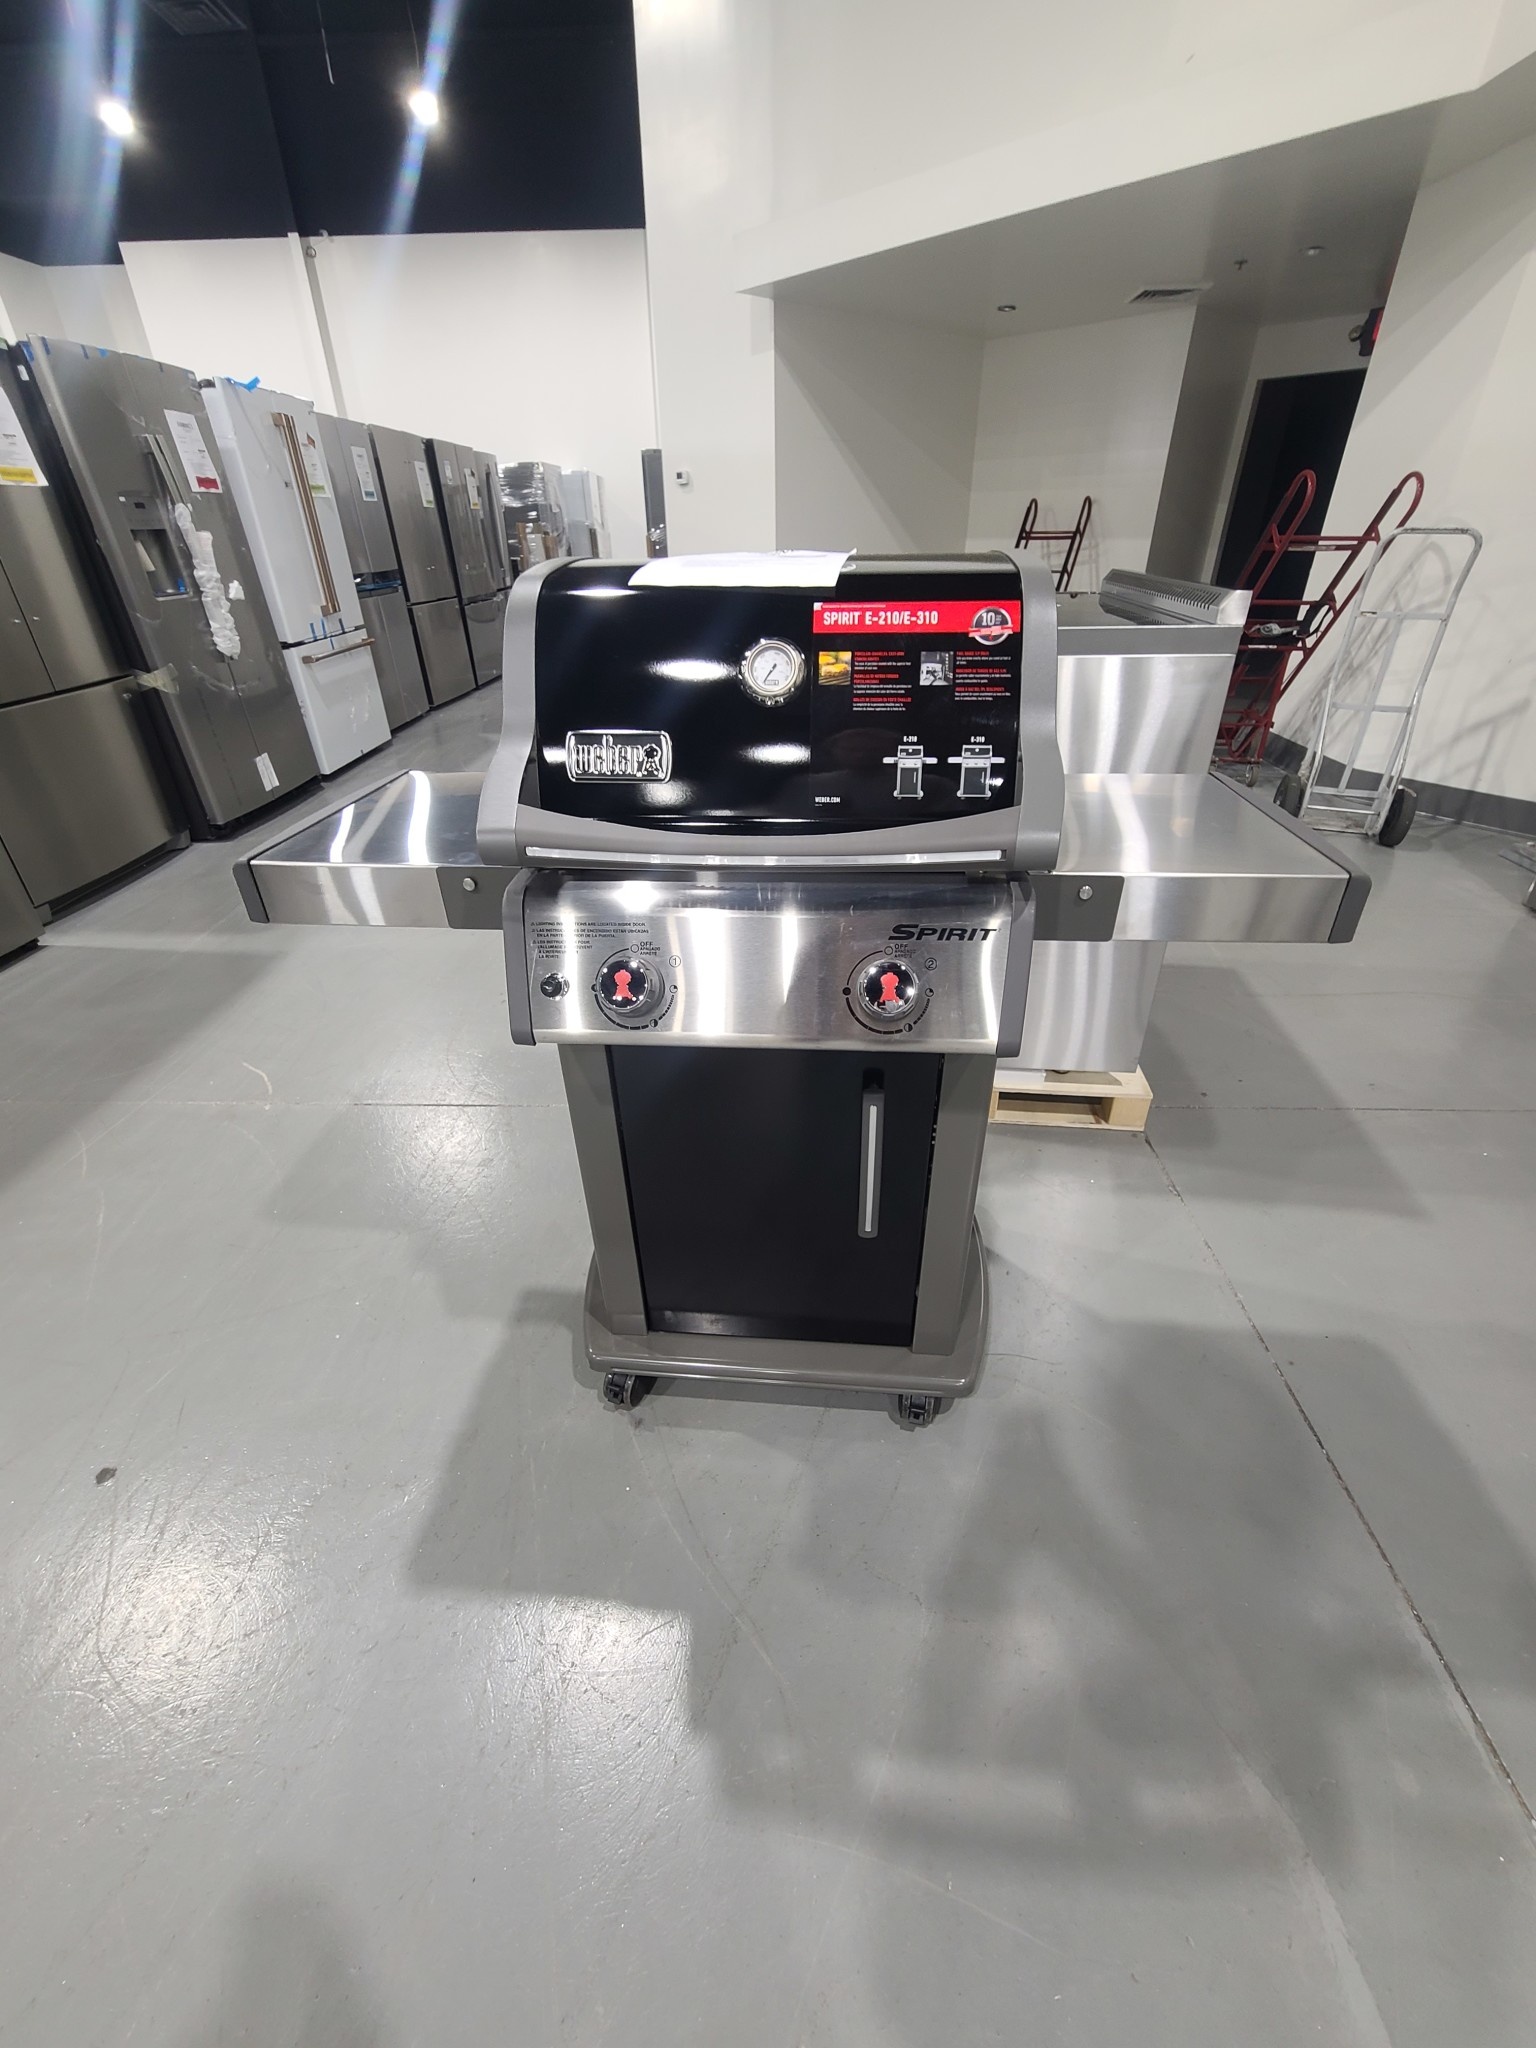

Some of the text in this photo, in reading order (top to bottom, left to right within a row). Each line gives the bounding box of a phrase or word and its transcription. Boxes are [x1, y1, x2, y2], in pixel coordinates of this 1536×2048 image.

[823, 610, 939, 626] SPIRIT E-210/E-310
[981, 611, 996, 626] 10
[903, 735, 986, 744] E-210 E-310
[814, 796, 841, 804] WEBER.COM
[887, 923, 998, 942] SPIRIT
